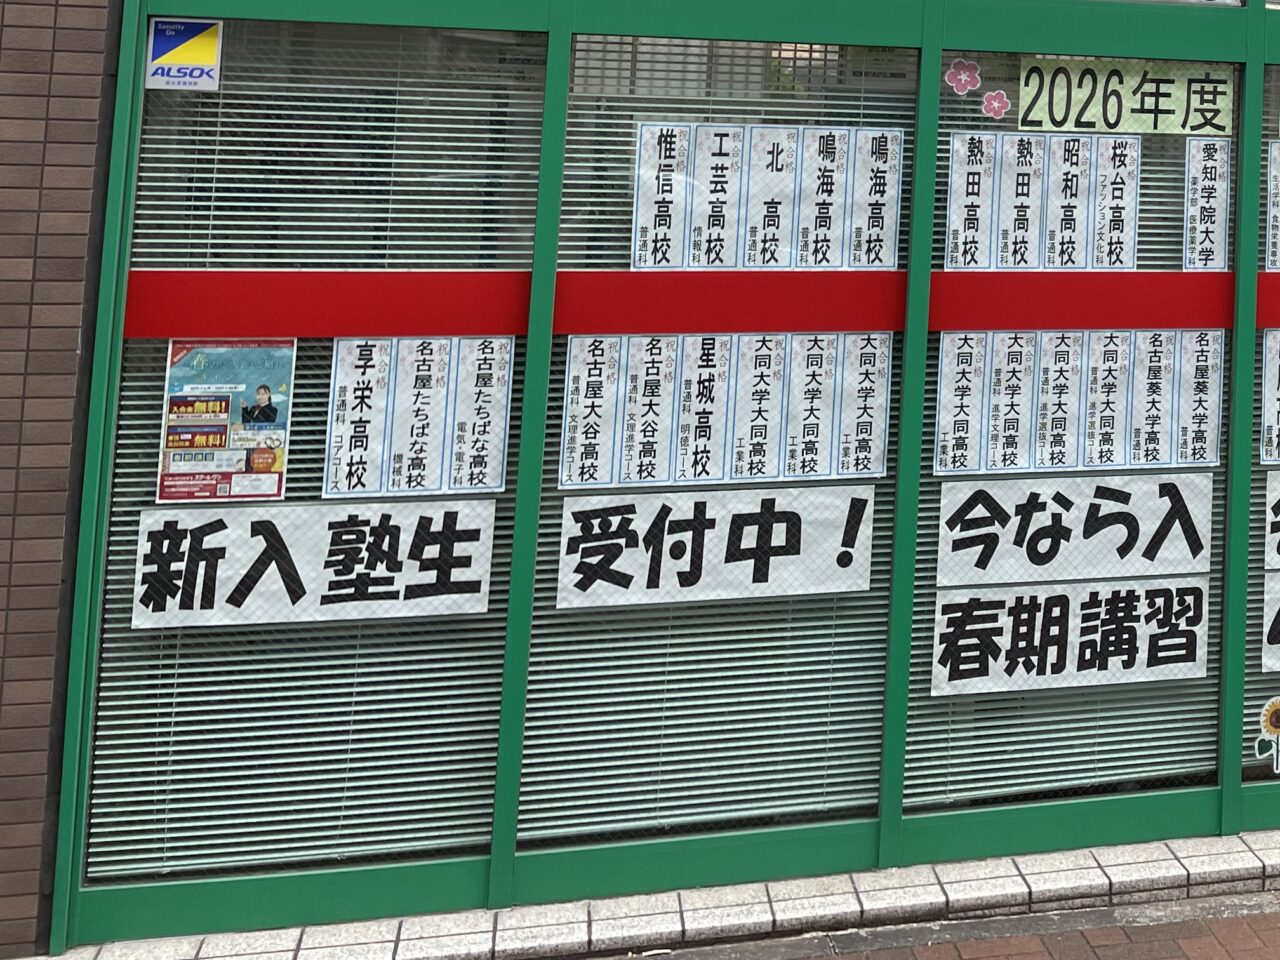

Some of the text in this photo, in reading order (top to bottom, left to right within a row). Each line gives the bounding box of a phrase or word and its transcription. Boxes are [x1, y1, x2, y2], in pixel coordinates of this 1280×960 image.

[151, 67, 215, 79] ALSOK
[1021, 66, 1234, 135] 2026年度
[638, 226, 648, 264] 普通科
[651, 128, 677, 265] 惟信高校
[705, 132, 730, 265] 工芸高校
[747, 226, 758, 264] 普通科
[760, 143, 784, 264] 北高校
[800, 227, 810, 264] 普通科
[812, 132, 836, 265] 鳴海高校
[853, 227, 863, 264] 普通科
[865, 133, 888, 264] 鳴海高校
[962, 136, 984, 266] 熱田高校
[1012, 137, 1033, 266] 熱田高校
[1059, 139, 1081, 266] 昭和高校
[1107, 140, 1128, 266] 桜台高校
[1199, 143, 1218, 266] 愛知学院大学
[330, 386, 348, 491] 普通科 コアコース
[346, 342, 376, 490] 享栄高校
[406, 341, 434, 488] 名古屋たちばな高校
[467, 340, 495, 486] 名古屋たちばな高校
[578, 339, 605, 482] 名古屋大谷高校
[636, 338, 663, 479] 名古屋大谷高校
[691, 338, 716, 478] 星城高校
[734, 438, 745, 476] 工業科
[748, 337, 773, 476] 大同大学大同高校
[787, 436, 798, 474] 工業科
[800, 336, 824, 474] 大同大学大同高校
[841, 434, 851, 472] 工業科
[854, 335, 877, 471] 大同大学大同高校
[951, 335, 974, 469] 大同大学大同高校
[1001, 334, 1024, 467] 大同大学大同高校
[1049, 334, 1071, 465] 大同大学大同高校
[1098, 333, 1119, 464] 大同大学大同高校
[1144, 333, 1163, 462] 名古屋葵大学高校
[1191, 332, 1210, 460] 名古屋葵大学高校
[139, 498, 869, 613] 新入塾生 受付中！
[946, 482, 1206, 571] 今なら入
[939, 587, 1203, 680] 春期講習
